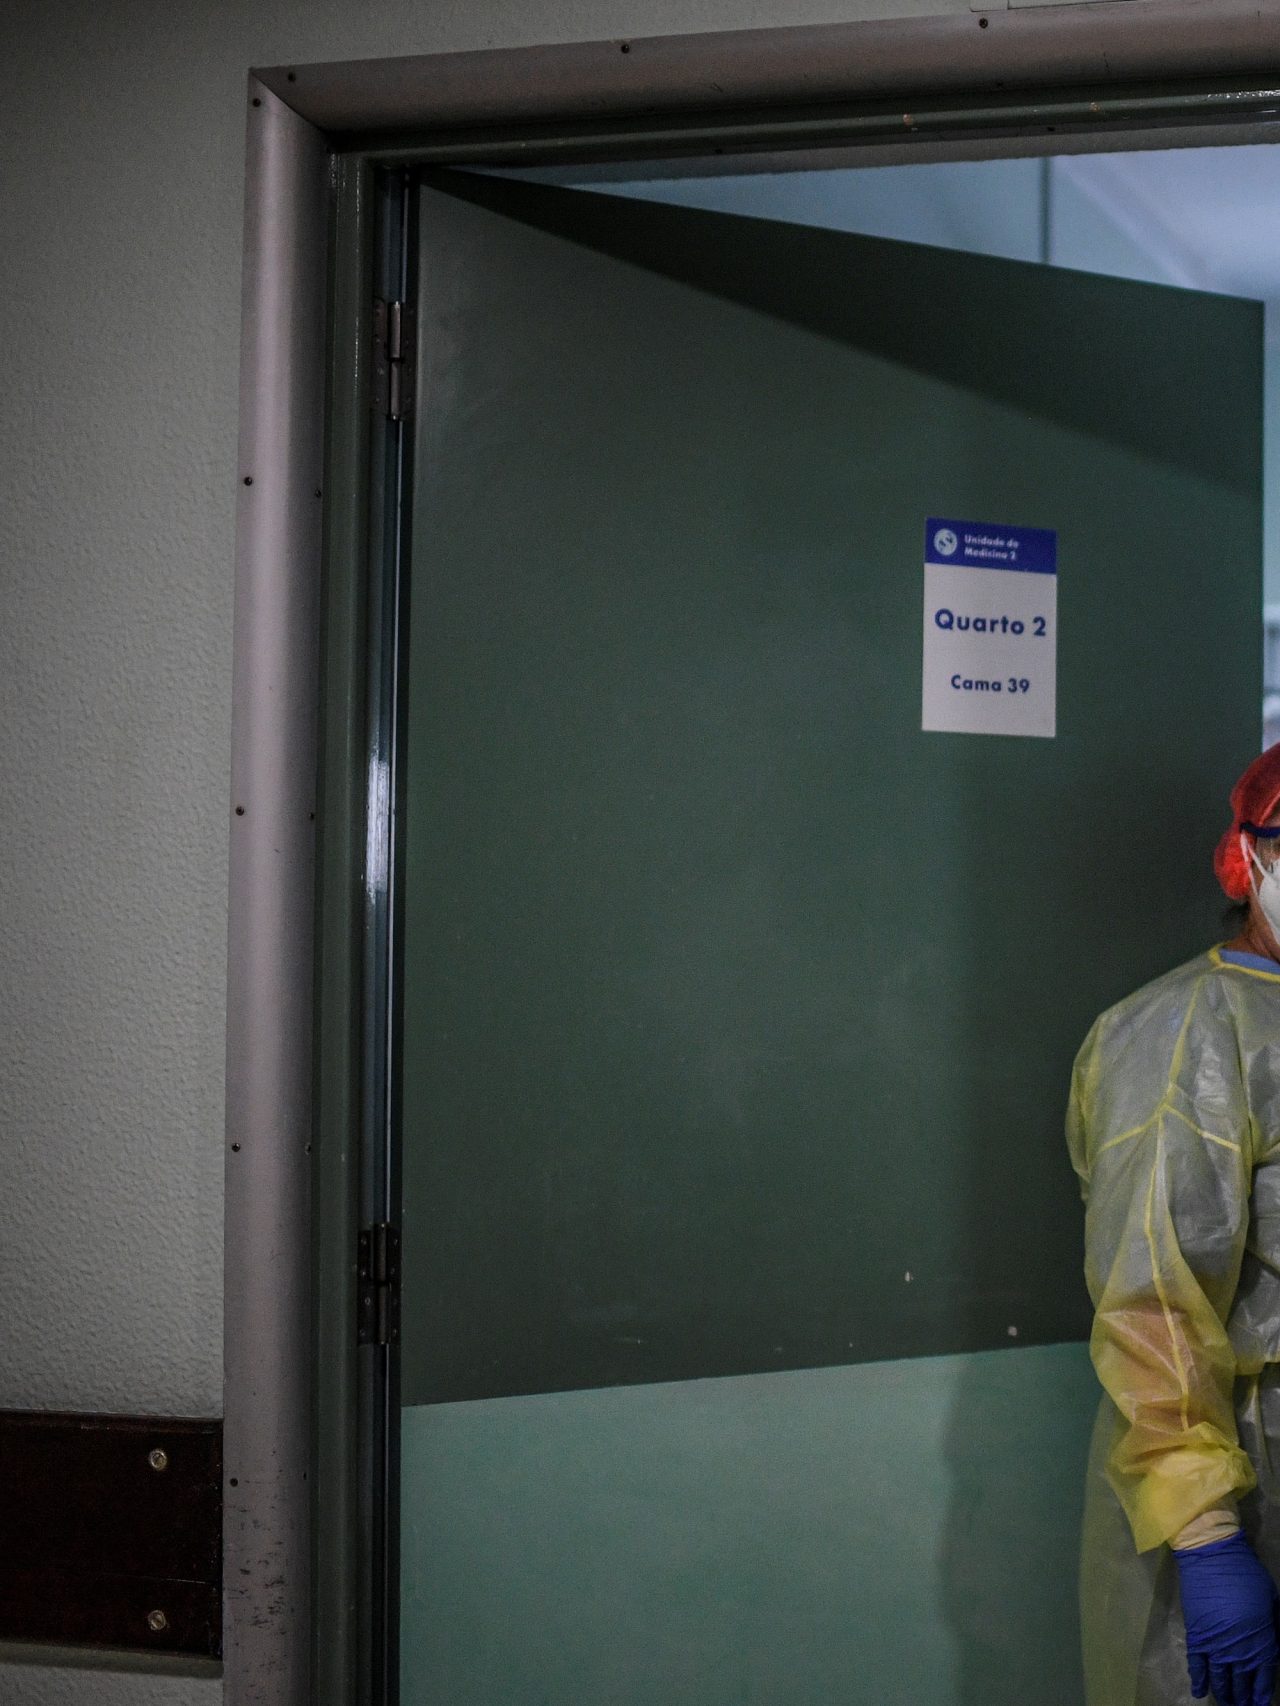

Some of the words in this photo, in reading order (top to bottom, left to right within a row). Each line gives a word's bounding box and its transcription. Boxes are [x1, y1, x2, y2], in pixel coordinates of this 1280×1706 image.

[964, 534, 1005, 546] Unidade
[964, 547, 1008, 559] Medicina
[1010, 551, 1016, 560] 2
[934, 608, 1025, 636] Quarto
[1032, 616, 1046, 637] 2
[950, 674, 1002, 692] Cama
[1007, 678, 1030, 694] 39
